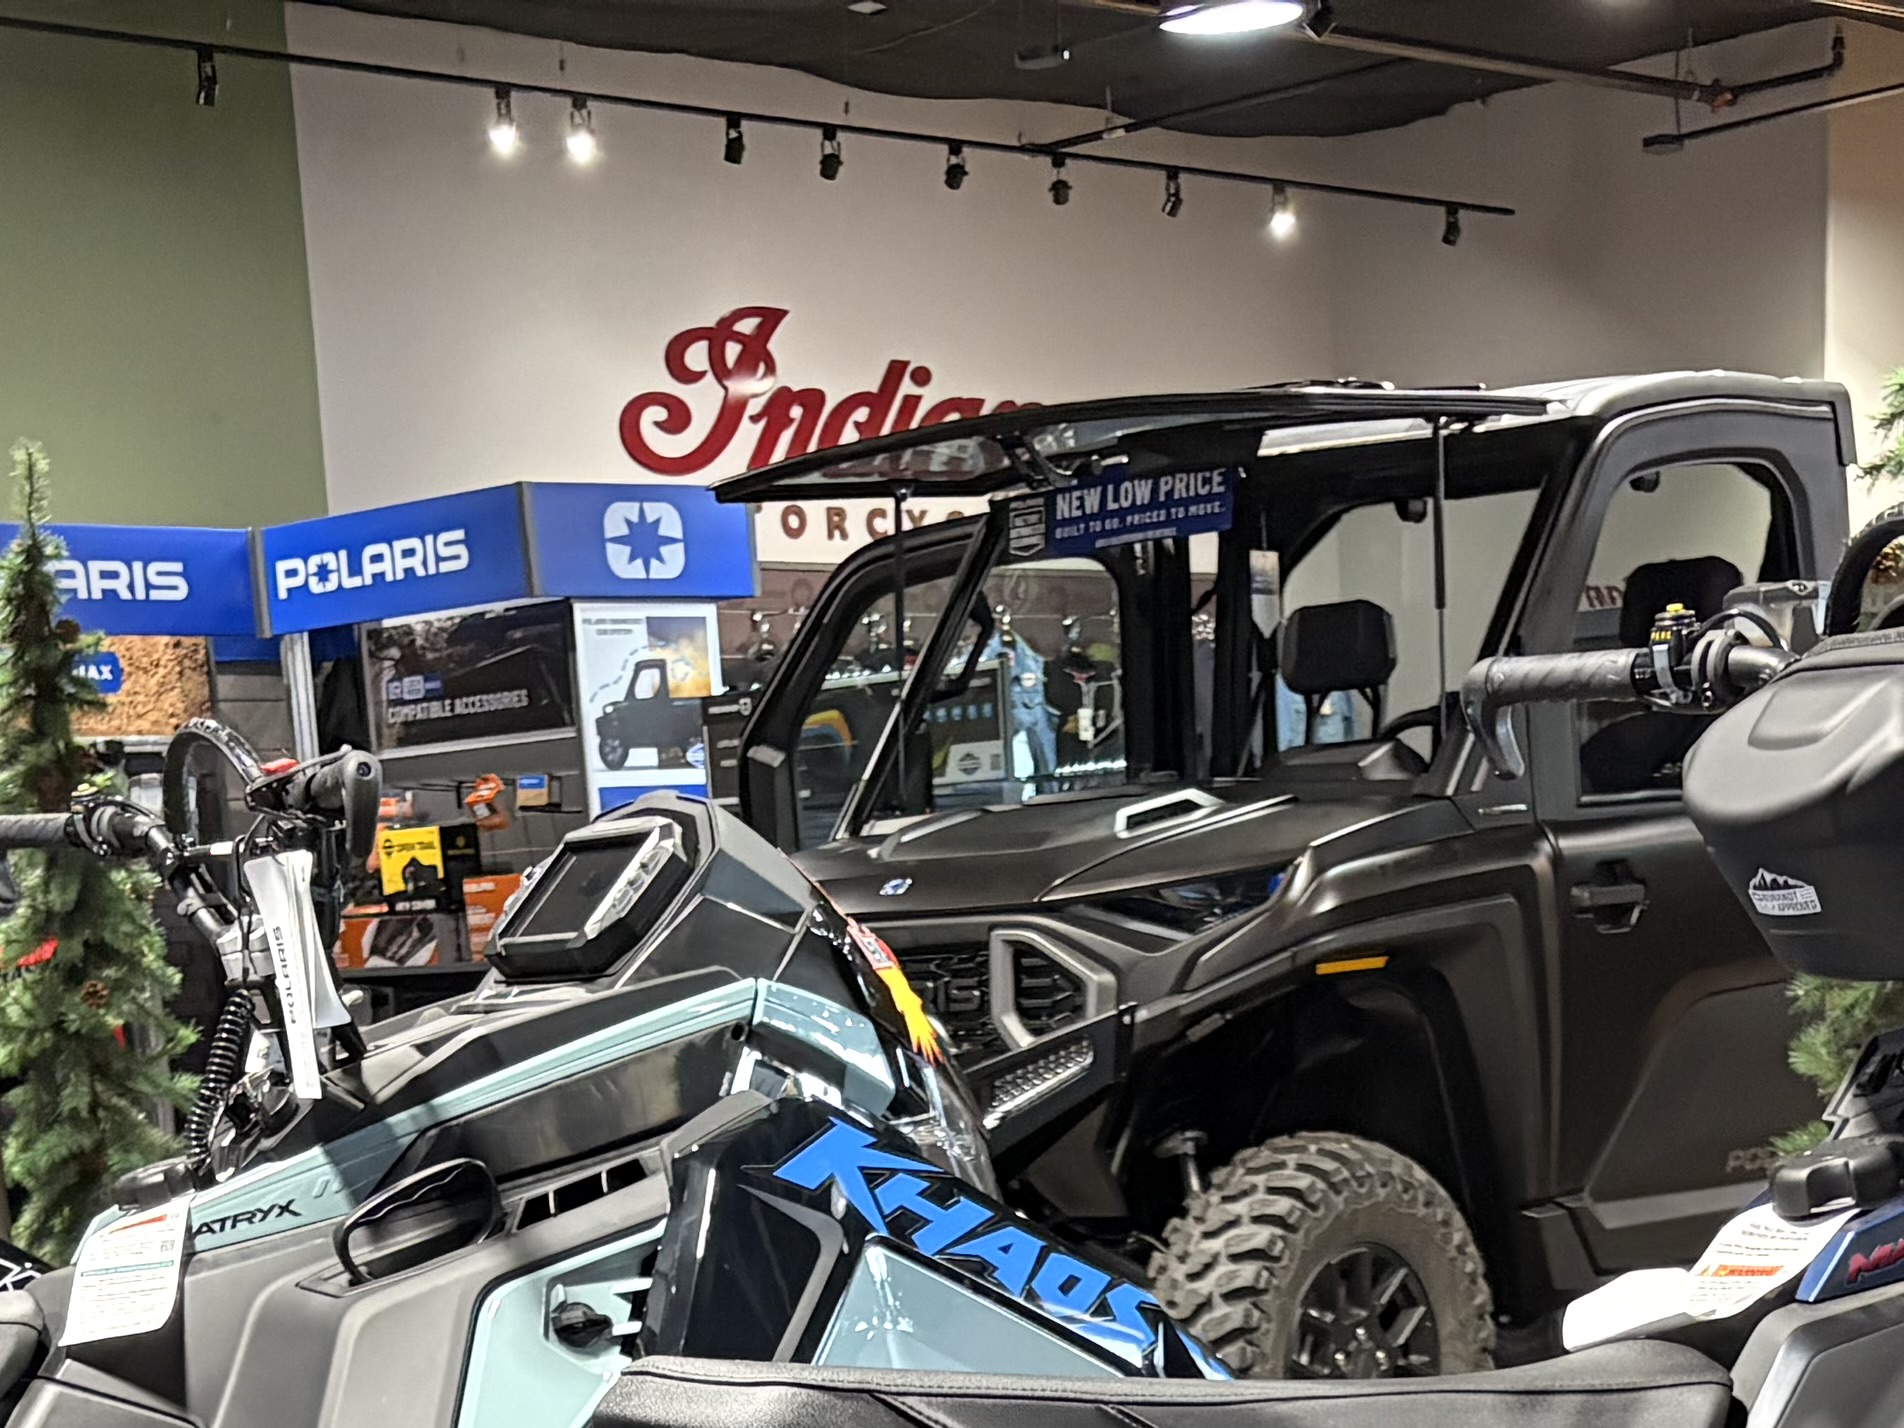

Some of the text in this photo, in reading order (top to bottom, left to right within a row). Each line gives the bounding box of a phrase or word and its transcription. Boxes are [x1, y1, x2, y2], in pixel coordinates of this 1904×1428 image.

[1055, 467, 1226, 521] NEW LOW PRICE
[1054, 523, 1085, 539] BUILT
[1088, 521, 1103, 533] TO
[1125, 509, 1167, 526] PRICED
[1169, 506, 1186, 519] TO
[1187, 500, 1227, 517] MOVE.
[275, 528, 469, 600] POLARIS
[387, 688, 529, 724] COMPATIBLE ACCESSORIES
[191, 1198, 303, 1240] ATRYX
[771, 1116, 1162, 1369] KHAOS
